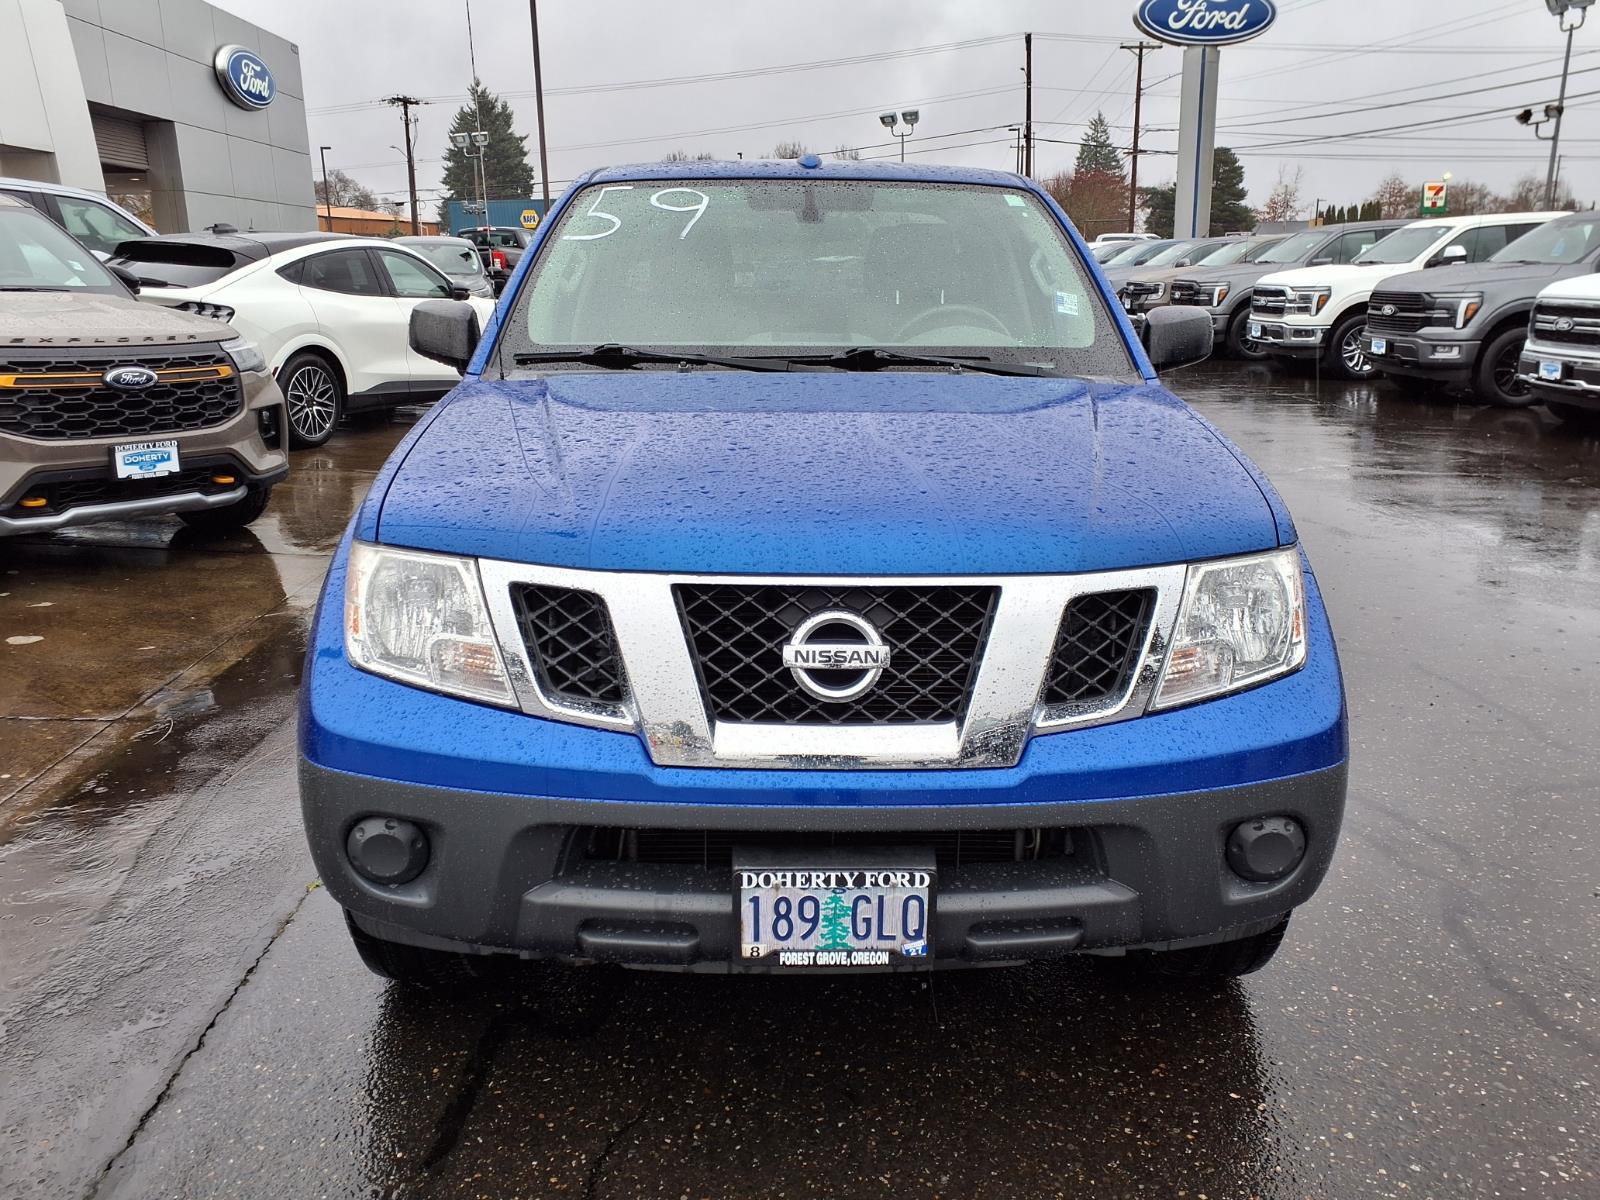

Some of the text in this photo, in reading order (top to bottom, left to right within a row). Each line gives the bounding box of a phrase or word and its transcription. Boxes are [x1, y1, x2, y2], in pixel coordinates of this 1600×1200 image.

[1168, 0, 1250, 30] Ford
[240, 59, 270, 98] Ford
[120, 372, 147, 385] Ford
[115, 440, 178, 453] DOHERTY FORD
[124, 453, 169, 464] DOHERTY
[794, 650, 880, 664] NISSAN
[741, 872, 930, 889] DOHERTY FORD
[779, 952, 889, 967] FOREST GROVE, OREGON
